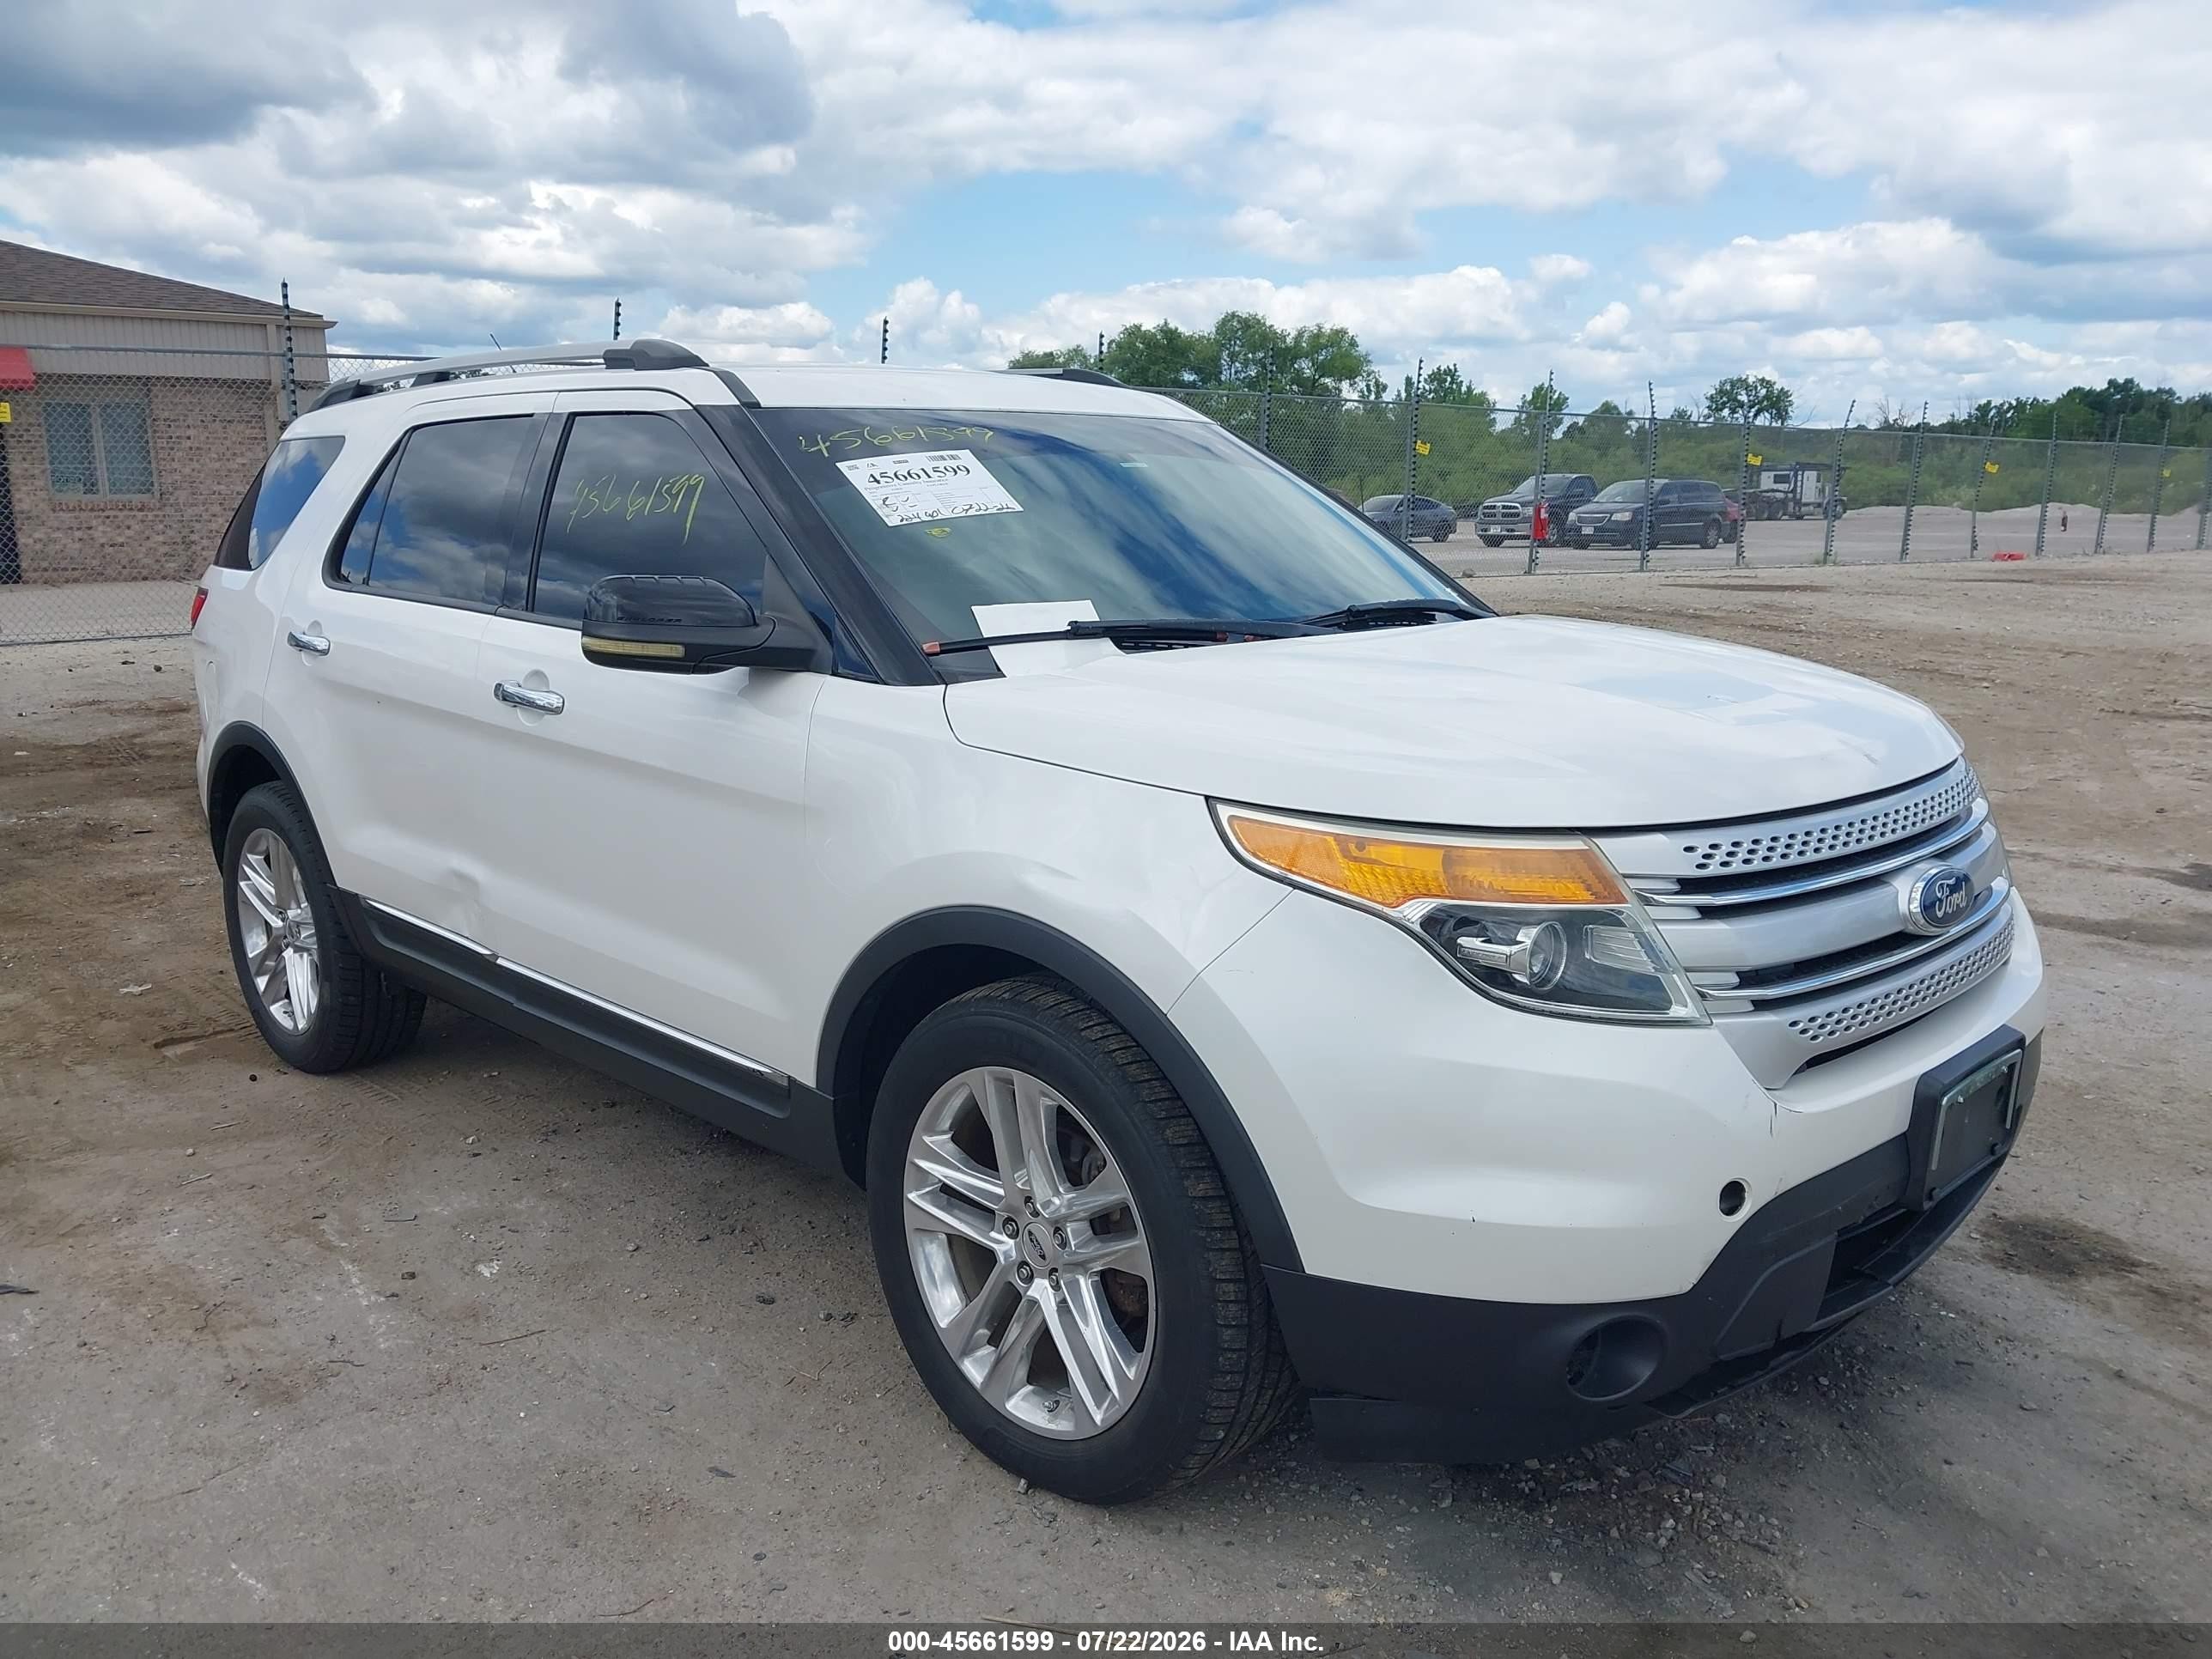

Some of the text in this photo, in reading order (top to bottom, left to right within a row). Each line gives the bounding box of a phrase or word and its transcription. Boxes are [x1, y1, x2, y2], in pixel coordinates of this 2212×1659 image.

[867, 464, 971, 486] 45661599
[566, 474, 705, 546] 45661599
[1935, 877, 1967, 919] Ford
